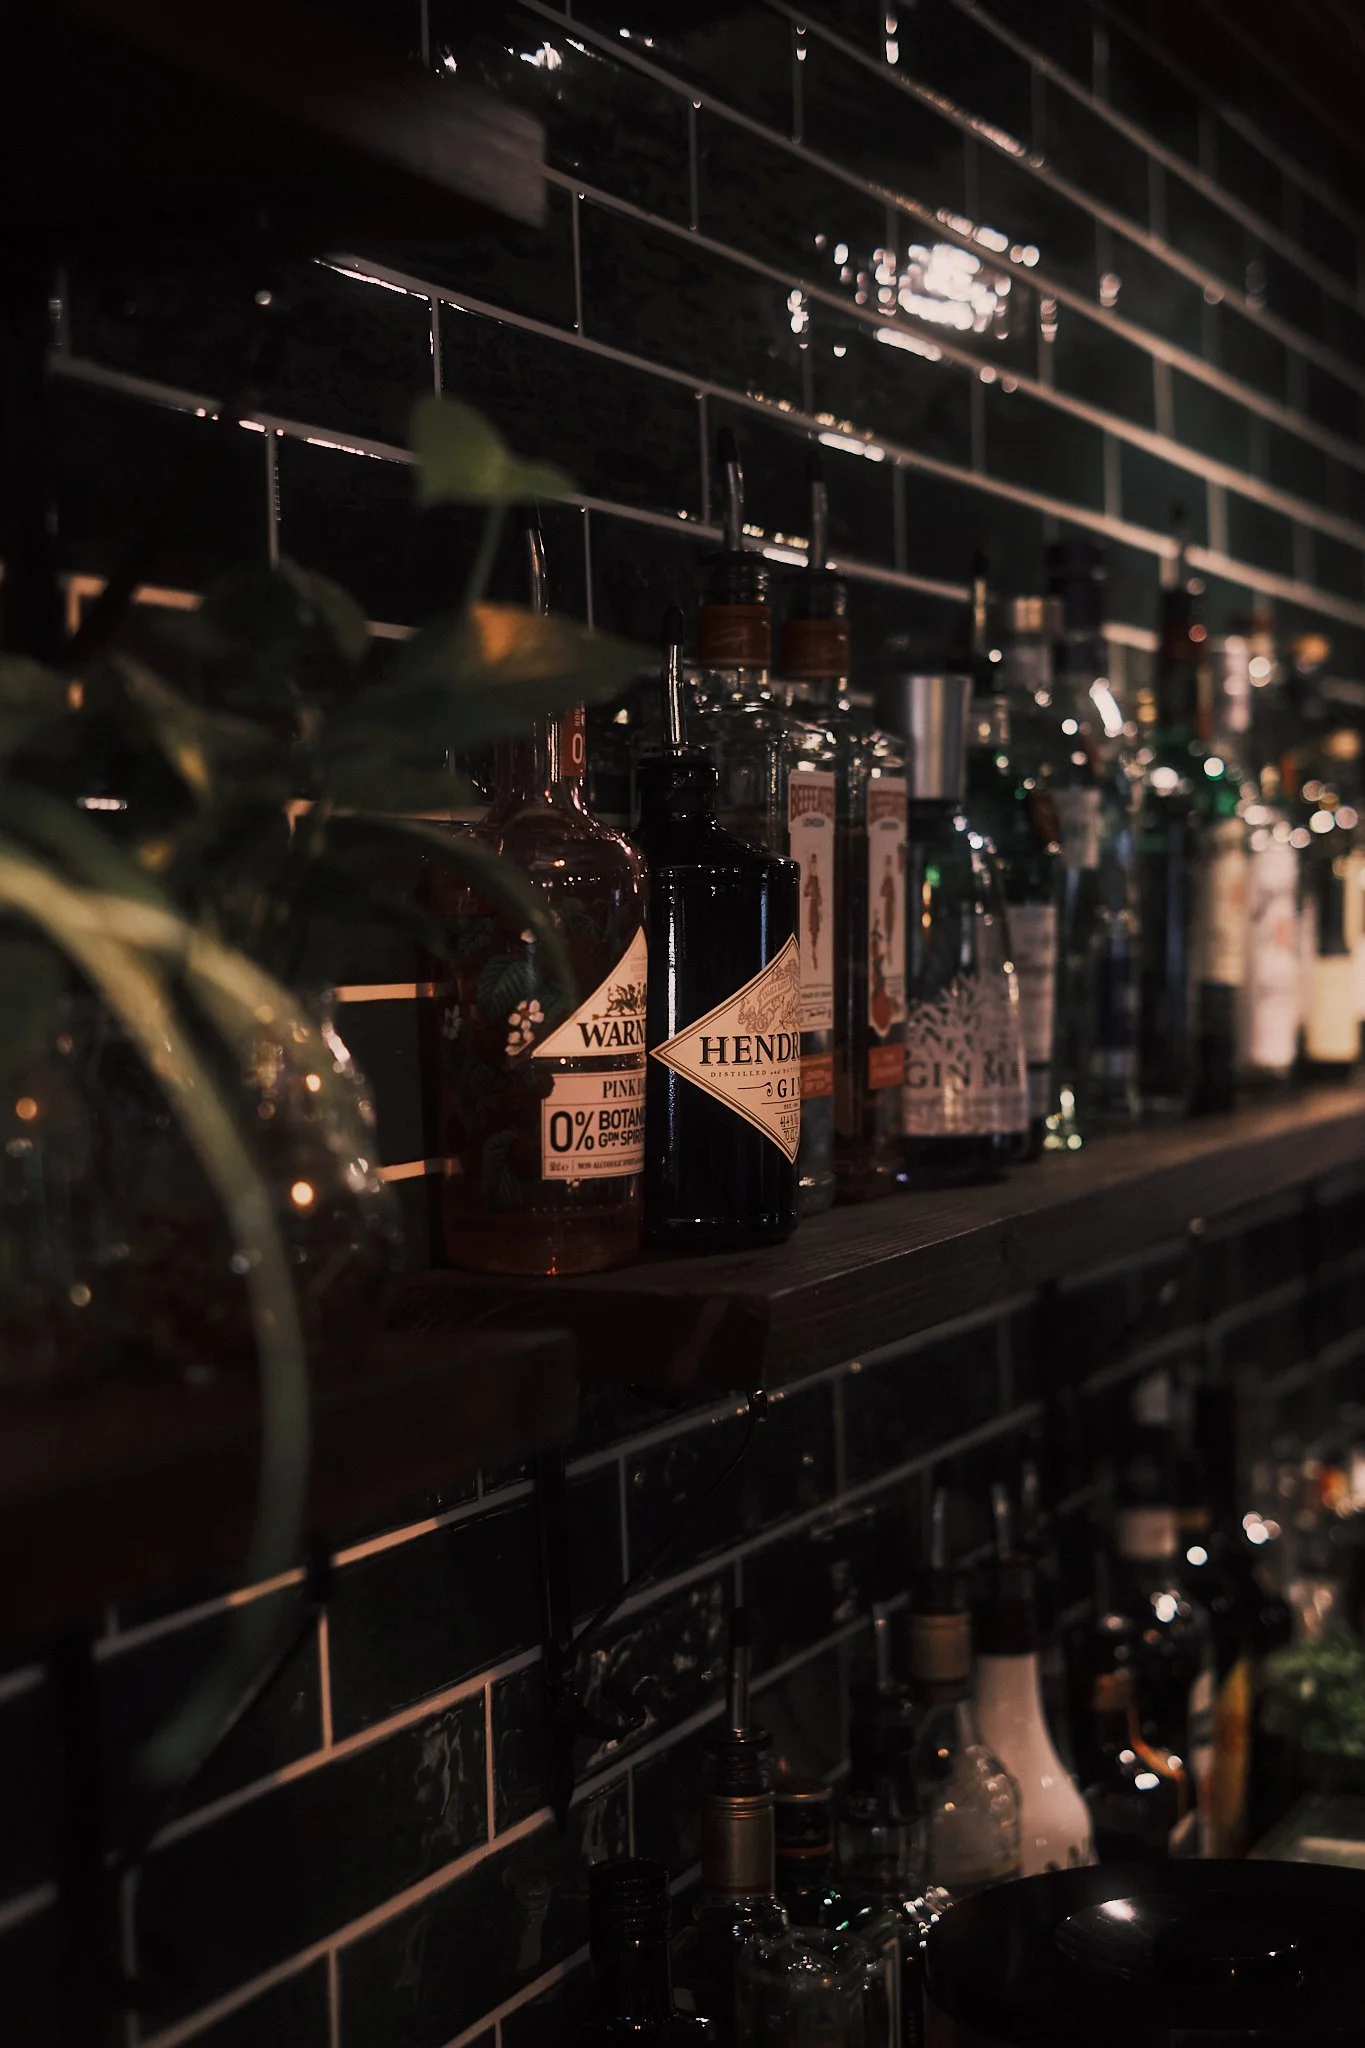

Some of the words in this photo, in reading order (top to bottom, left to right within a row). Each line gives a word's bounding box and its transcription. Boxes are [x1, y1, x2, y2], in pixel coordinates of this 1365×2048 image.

[699, 1031, 800, 1067] HENDR
[710, 1069, 767, 1078] DISTILLED
[603, 1079, 636, 1099] PINK
[550, 1110, 595, 1152] 0%
